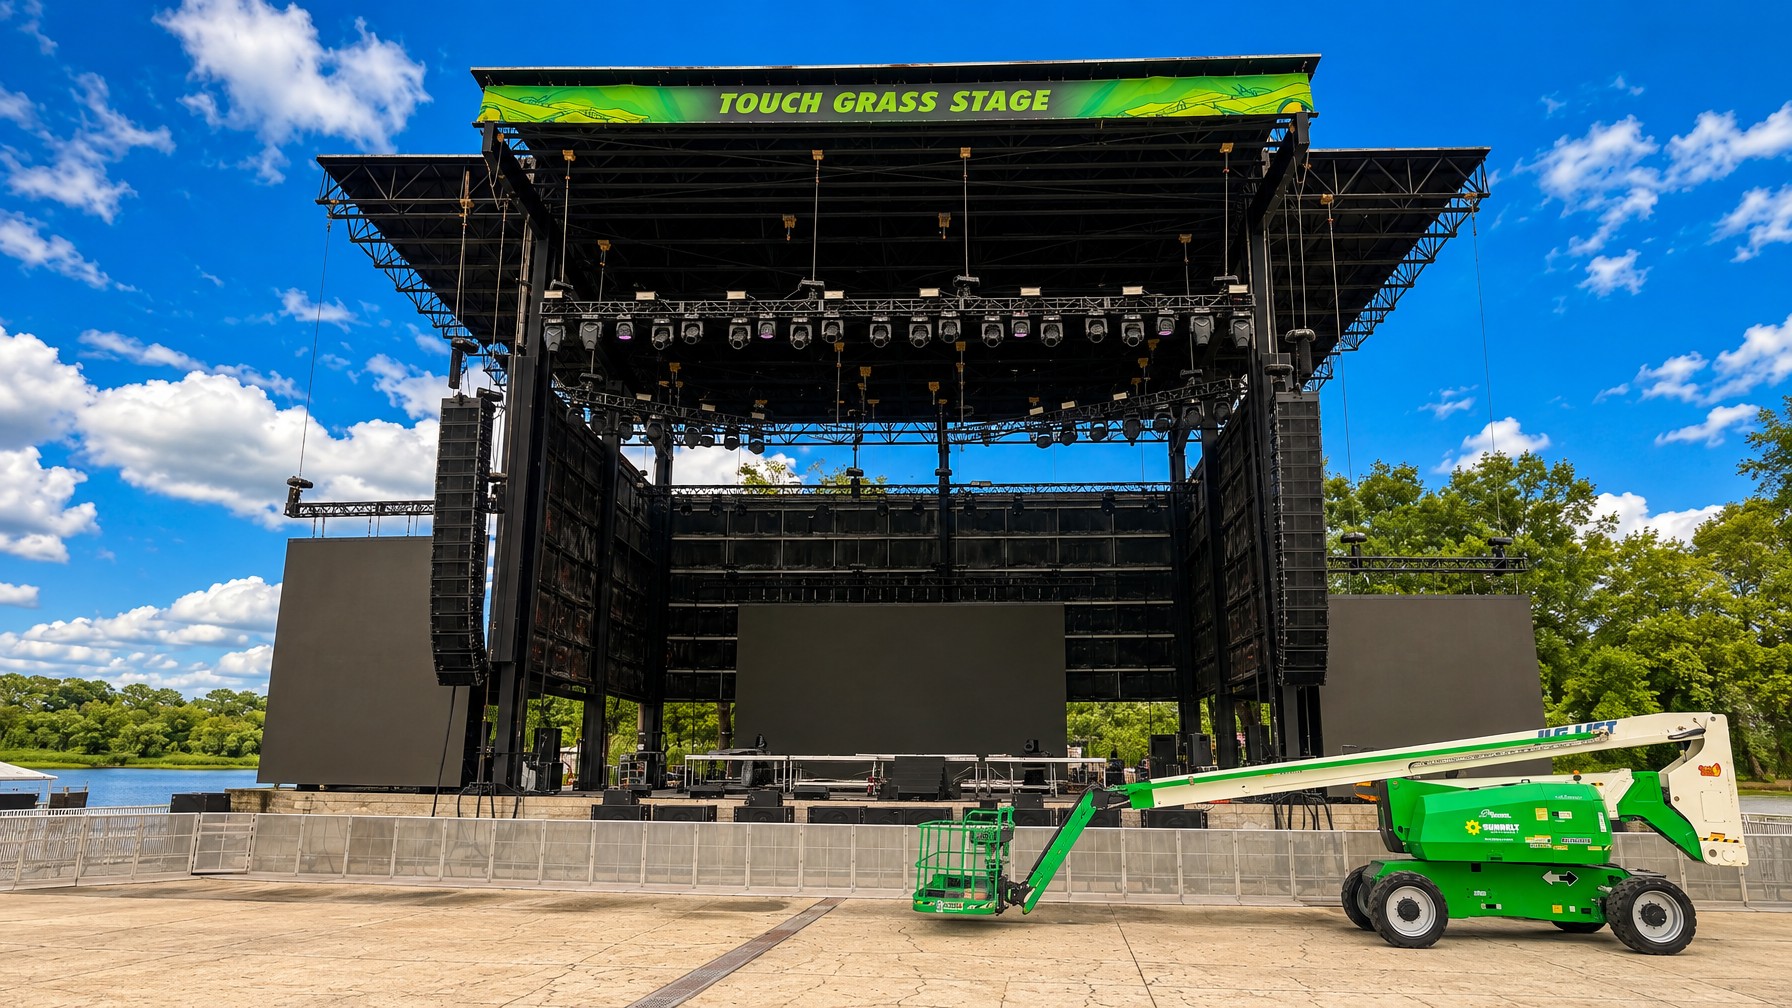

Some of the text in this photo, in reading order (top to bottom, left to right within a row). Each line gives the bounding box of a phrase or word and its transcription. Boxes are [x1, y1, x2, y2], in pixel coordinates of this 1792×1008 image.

[719, 89, 1052, 114] TOUCH GRASS STAGE
